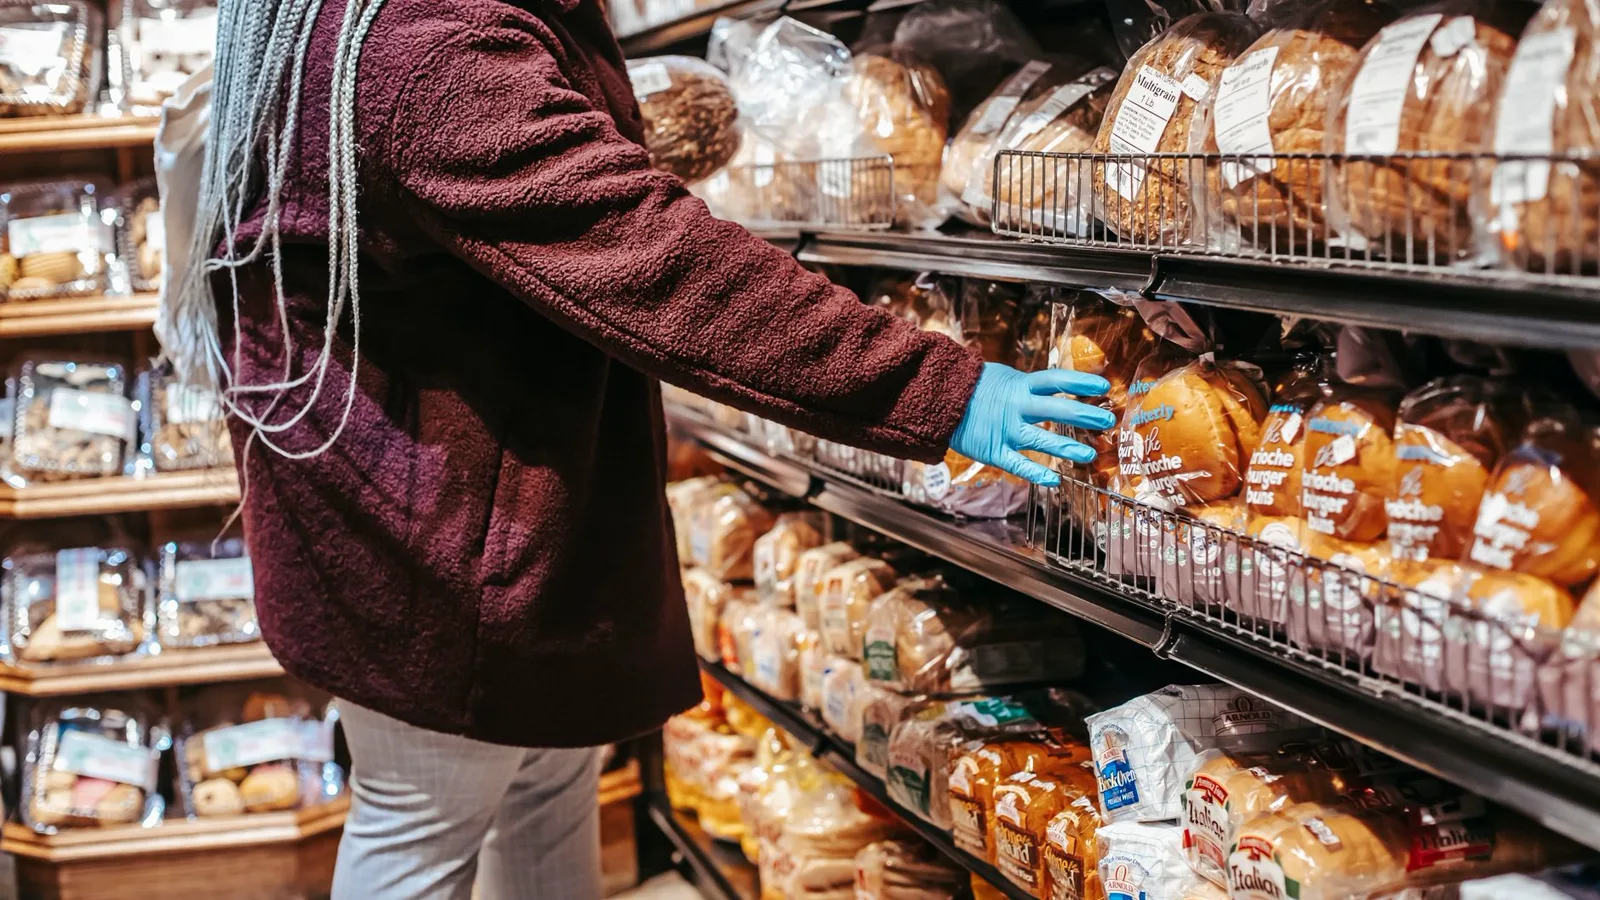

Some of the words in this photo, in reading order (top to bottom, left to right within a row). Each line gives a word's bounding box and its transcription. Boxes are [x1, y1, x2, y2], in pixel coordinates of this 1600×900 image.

[1136, 74, 1177, 104] Multigrain
[1141, 95, 1146, 103] 1
[1130, 402, 1175, 426] akerly
[1144, 426, 1162, 456] the
[1148, 474, 1181, 495] urge
[1167, 492, 1187, 507] ns
[1246, 485, 1275, 506] buns
[1224, 710, 1272, 723] ARNOLD
[1187, 799, 1226, 842] Italian
[1107, 880, 1135, 893] ARNOLD
[1231, 864, 1281, 899] Italian
